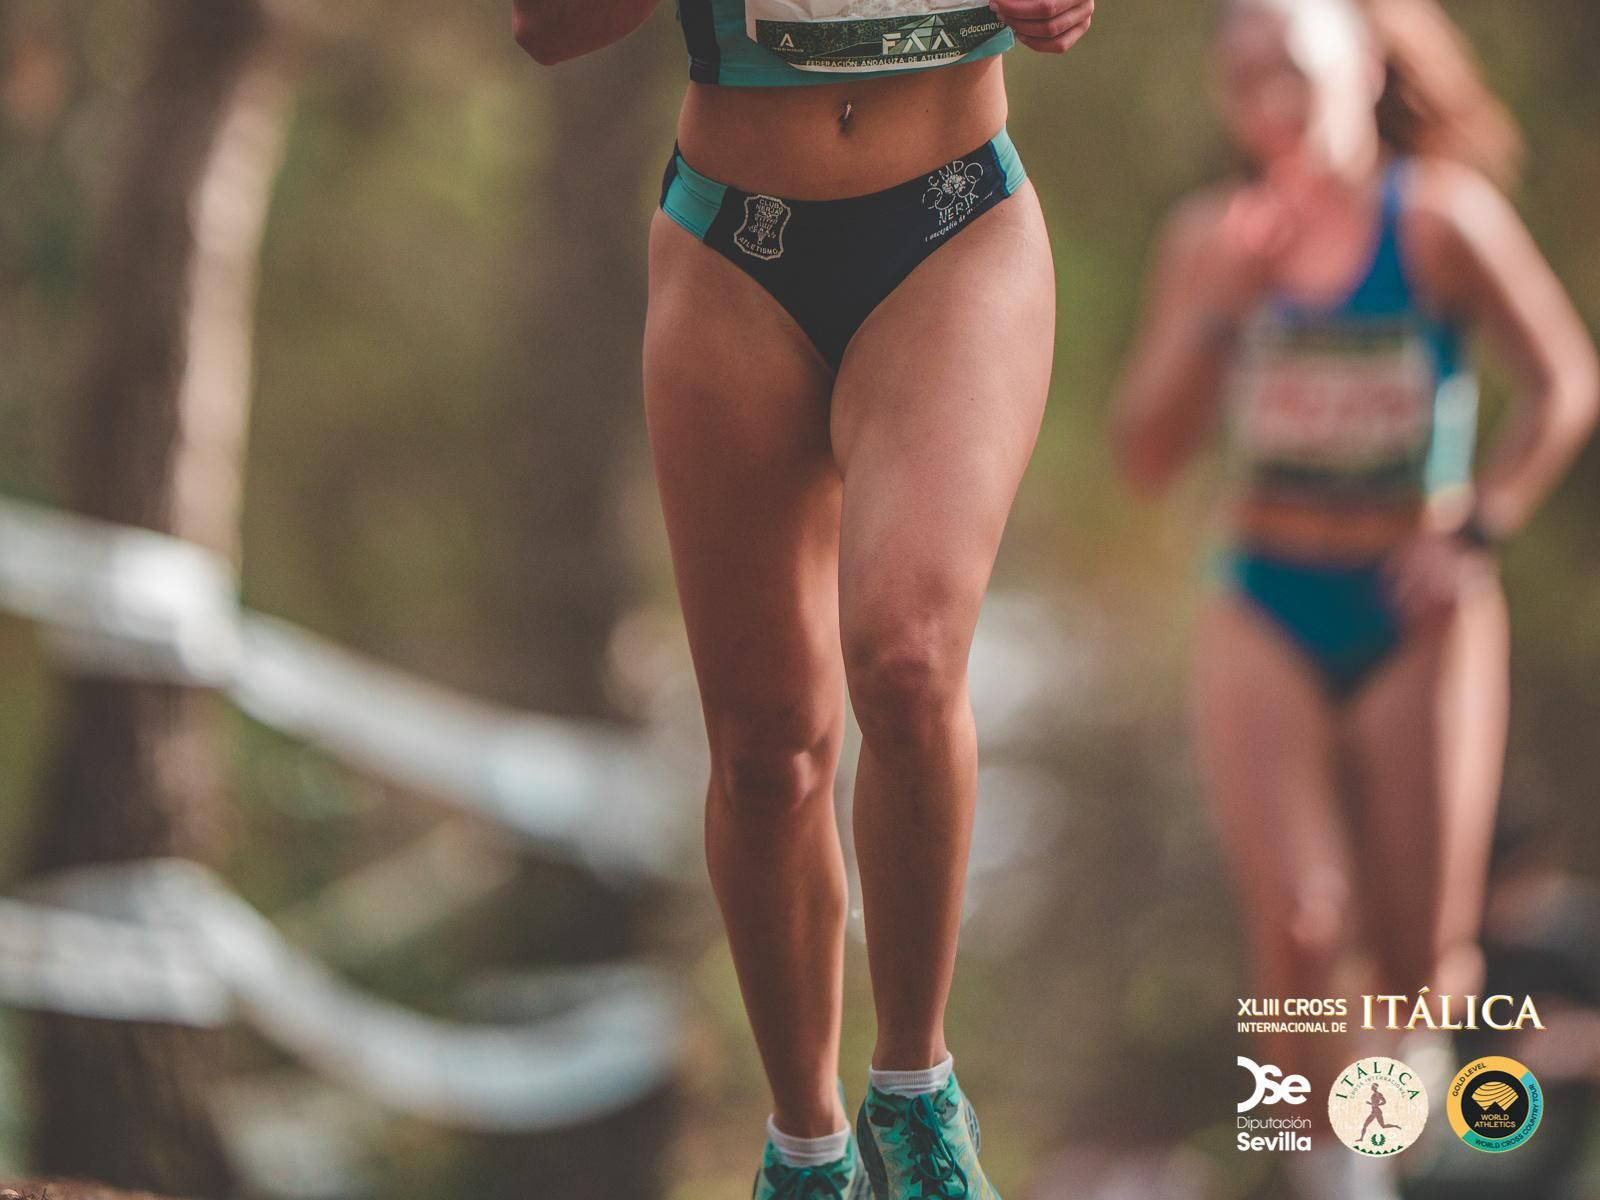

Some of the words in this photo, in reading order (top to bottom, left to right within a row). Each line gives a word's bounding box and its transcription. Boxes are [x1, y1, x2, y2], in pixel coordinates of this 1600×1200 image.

[806, 58, 858, 67] FEDERACIÓN
[861, 56, 905, 66] ANDALUZA
[908, 55, 918, 63] DE
[921, 50, 961, 62] ATLETISMO
